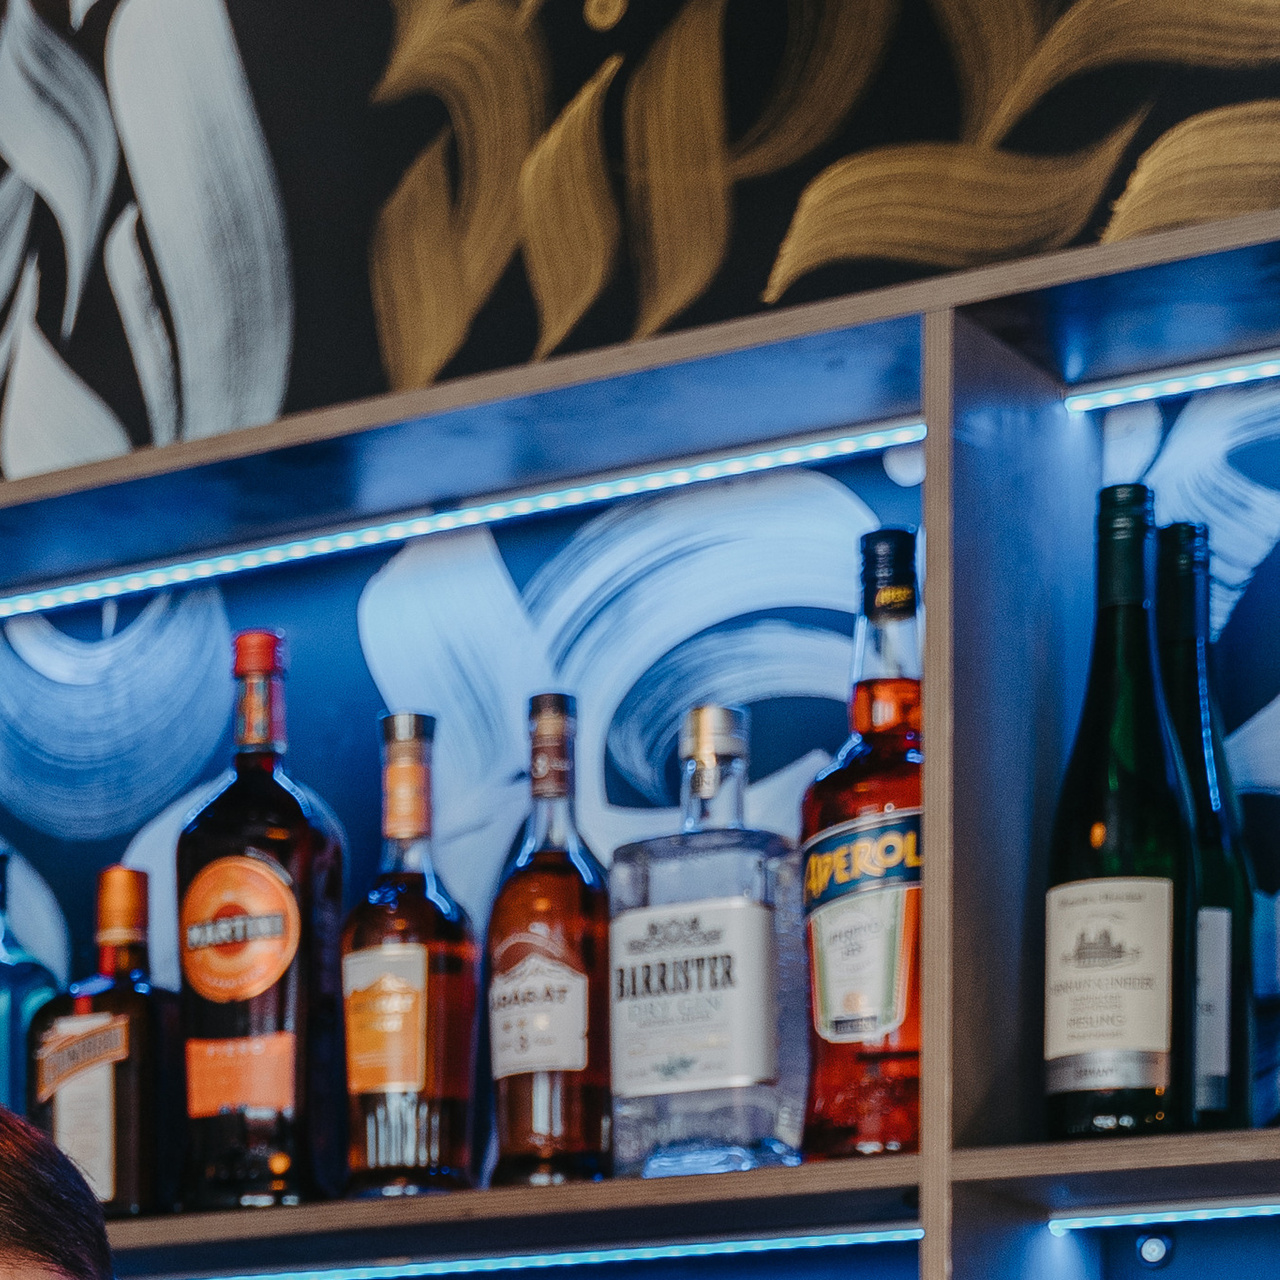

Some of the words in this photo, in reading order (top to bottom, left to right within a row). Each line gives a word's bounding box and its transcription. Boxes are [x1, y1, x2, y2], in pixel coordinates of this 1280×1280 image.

[805, 832, 922, 899] APEROL
[187, 913, 284, 948] MARTINI
[616, 954, 735, 999] BARRISTER
